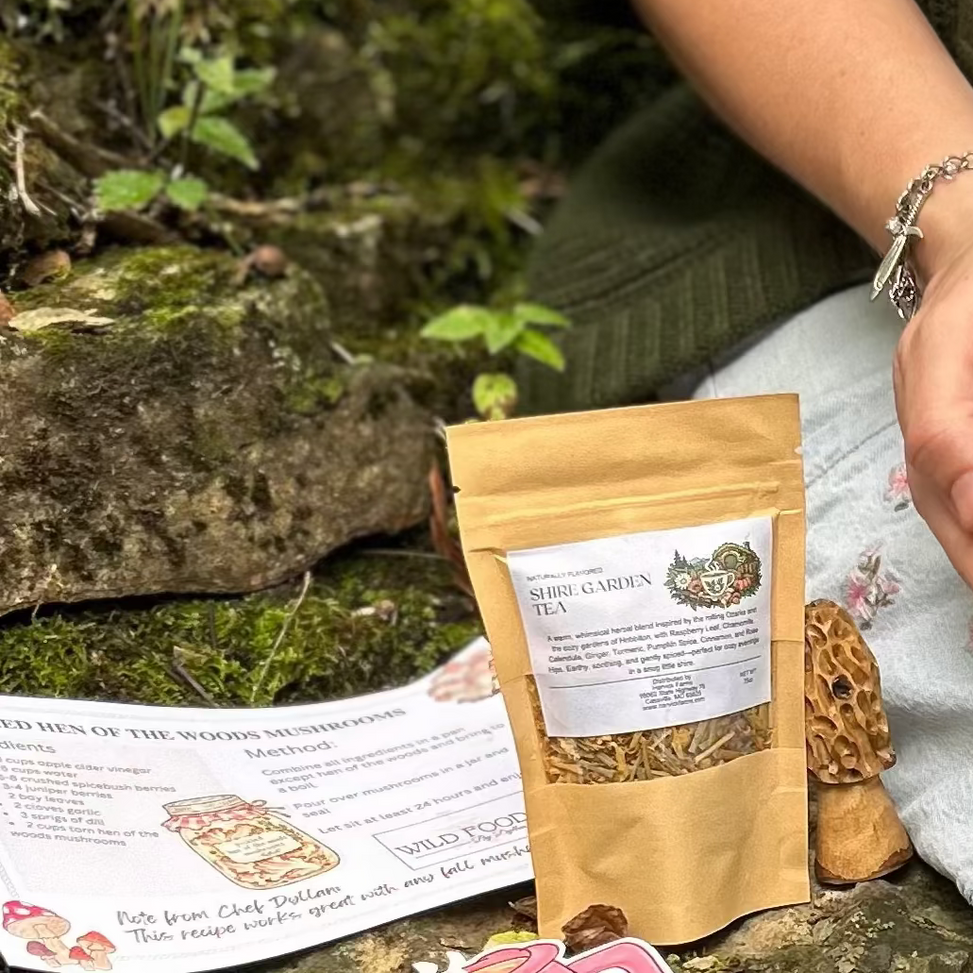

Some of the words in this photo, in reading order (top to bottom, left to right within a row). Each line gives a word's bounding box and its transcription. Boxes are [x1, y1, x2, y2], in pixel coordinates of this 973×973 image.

[526, 572, 566, 581] NATURALLY
[530, 584, 579, 601] SHIRE
[582, 573, 652, 594] GARDEN
[533, 601, 567, 616] TEA
[575, 629, 610, 638] whimsical
[611, 626, 633, 634] herbal
[634, 622, 653, 630] blend
[655, 619, 682, 628] inspired
[581, 640, 609, 650] gardens
[670, 628, 703, 636] Raspberry
[647, 641, 677, 650] Pumpkin
[641, 654, 661, 664] gently
[0, 719, 32, 730] ED
[36, 721, 87, 735] HEN
[91, 726, 121, 737] OF
[126, 729, 175, 740] THE
[178, 730, 261, 741] WOODS
[264, 708, 407, 739] MUSHROOMS
[244, 740, 338, 759] Method:
[261, 764, 323, 777] Combine
[325, 759, 341, 767] all
[344, 740, 415, 763] ingredients
[417, 737, 429, 745] in
[442, 727, 466, 740] pan
[269, 773, 314, 785] except
[317, 768, 344, 777] hen
[346, 764, 359, 773] of
[361, 759, 385, 769] the
[387, 747, 429, 761] woods
[431, 738, 454, 751] and
[456, 729, 489, 744] bring
[490, 723, 506, 731] to
[6, 758, 35, 766] cups
[37, 761, 72, 769] apple
[75, 764, 104, 772] cider
[107, 766, 152, 776] vinegar
[12, 767, 41, 775] cups
[43, 770, 77, 778] water
[21, 777, 69, 786] crushed
[72, 781, 132, 791] spicebush
[135, 785, 177, 793] berries
[293, 799, 327, 811] Pour
[329, 791, 359, 803] over
[362, 771, 440, 797] mushrooms
[440, 766, 454, 774] in
[466, 753, 483, 766] jar
[485, 747, 509, 758] and
[19, 793, 41, 803] bay
[45, 796, 84, 805] leaves
[26, 785, 68, 795] juniper
[72, 789, 113, 799] berries
[25, 803, 65, 813] cloves
[68, 808, 102, 816] garlic
[318, 825, 340, 834] Let
[344, 820, 361, 829] sit
[364, 817, 377, 825] at
[379, 806, 416, 820] least
[416, 801, 431, 811] 24
[433, 788, 471, 804] hours
[474, 779, 499, 790] and
[501, 771, 523, 782] enj
[31, 813, 68, 823] sprigs
[86, 818, 105, 826] dill
[302, 808, 331, 818] seal
[11, 830, 52, 840] woods
[54, 834, 127, 846] mushrooms
[37, 823, 67, 832] cups
[69, 826, 95, 834] torn
[98, 828, 121, 836] hen
[394, 830, 459, 856] WILD
[124, 928, 174, 944] This
[181, 925, 236, 941] recipe
[243, 911, 303, 931] works
[308, 895, 355, 918] great
[365, 883, 397, 898] with
[404, 874, 435, 888] any
[440, 860, 474, 879] fall
[116, 909, 157, 926] Note
[164, 910, 210, 926] from
[218, 900, 265, 919] Chef
